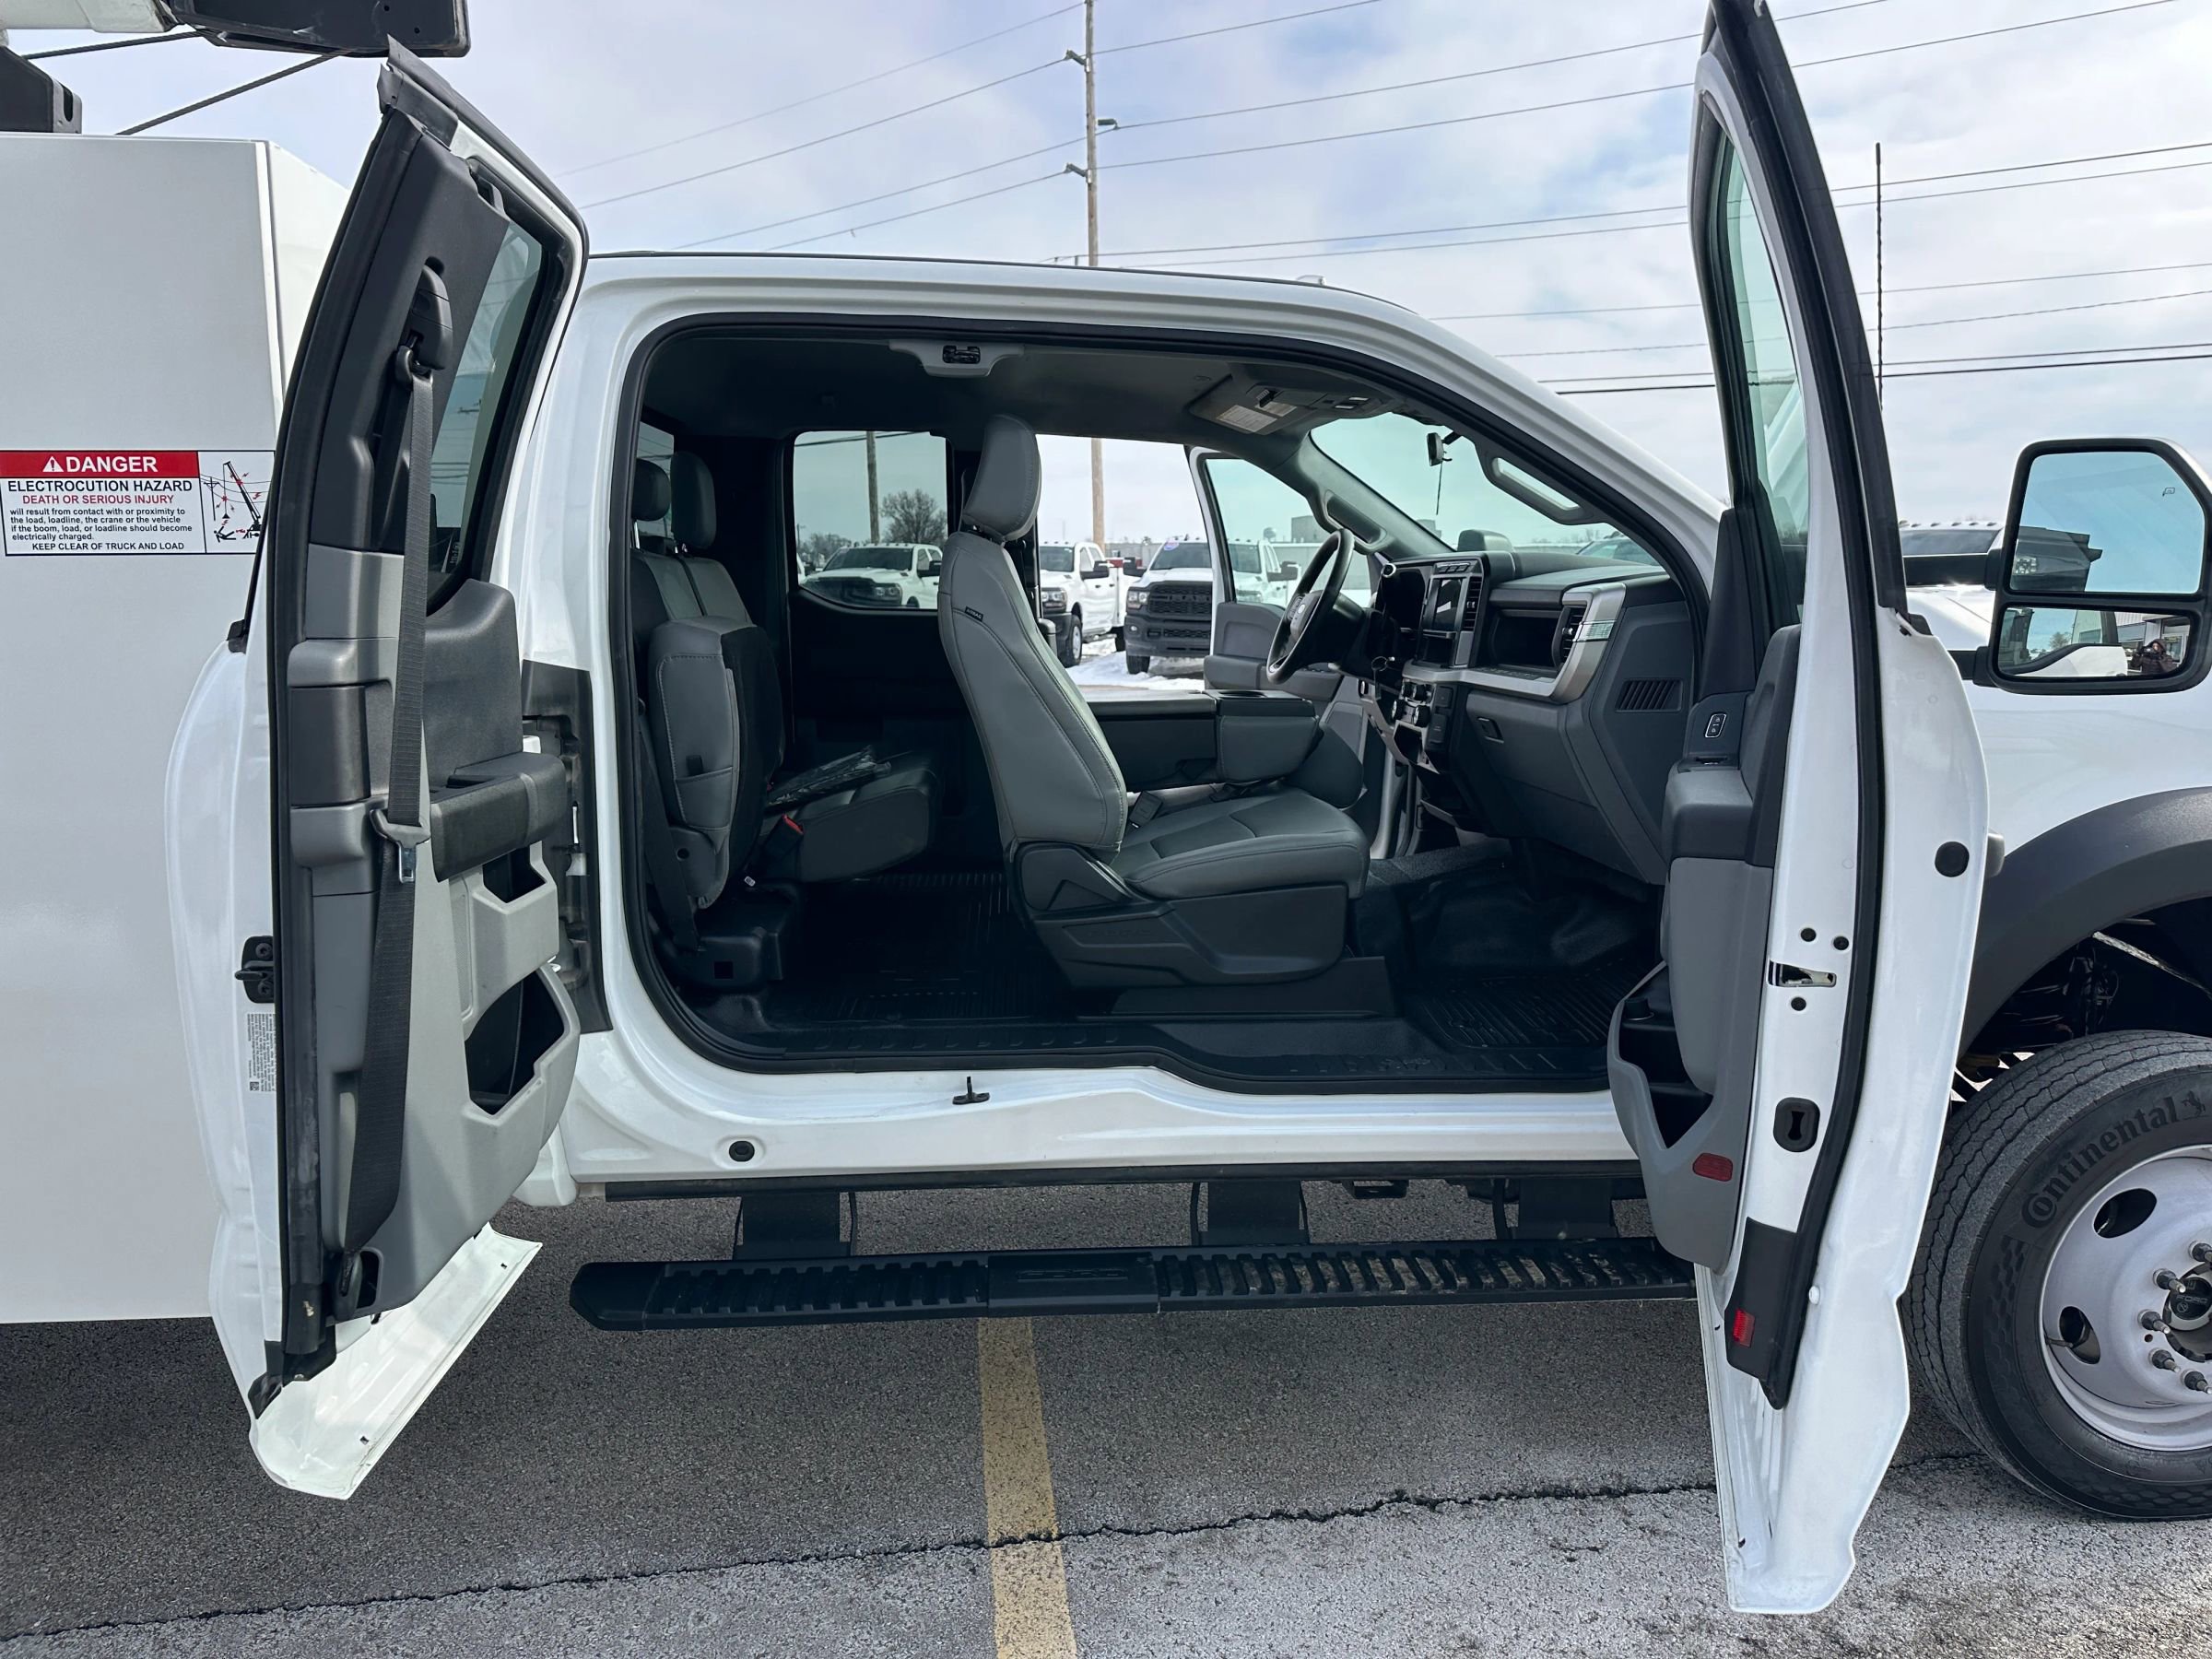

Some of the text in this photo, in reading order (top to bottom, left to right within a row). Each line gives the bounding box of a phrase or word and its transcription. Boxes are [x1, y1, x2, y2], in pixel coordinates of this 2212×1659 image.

[65, 456, 159, 473] DANGER
[7, 480, 193, 492] ELECTROCUTION HAZARD
[22, 494, 174, 504] DEATH OR SERIOUS INJURY
[136, 508, 174, 516] proximity
[26, 516, 46, 524] load,
[48, 516, 83, 524] loadline,
[61, 524, 82, 533] load,
[105, 542, 136, 550] TRUCK
[138, 542, 158, 550] AND
[159, 542, 184, 550] LOAD
[2021, 1097, 2181, 1229] Continental
